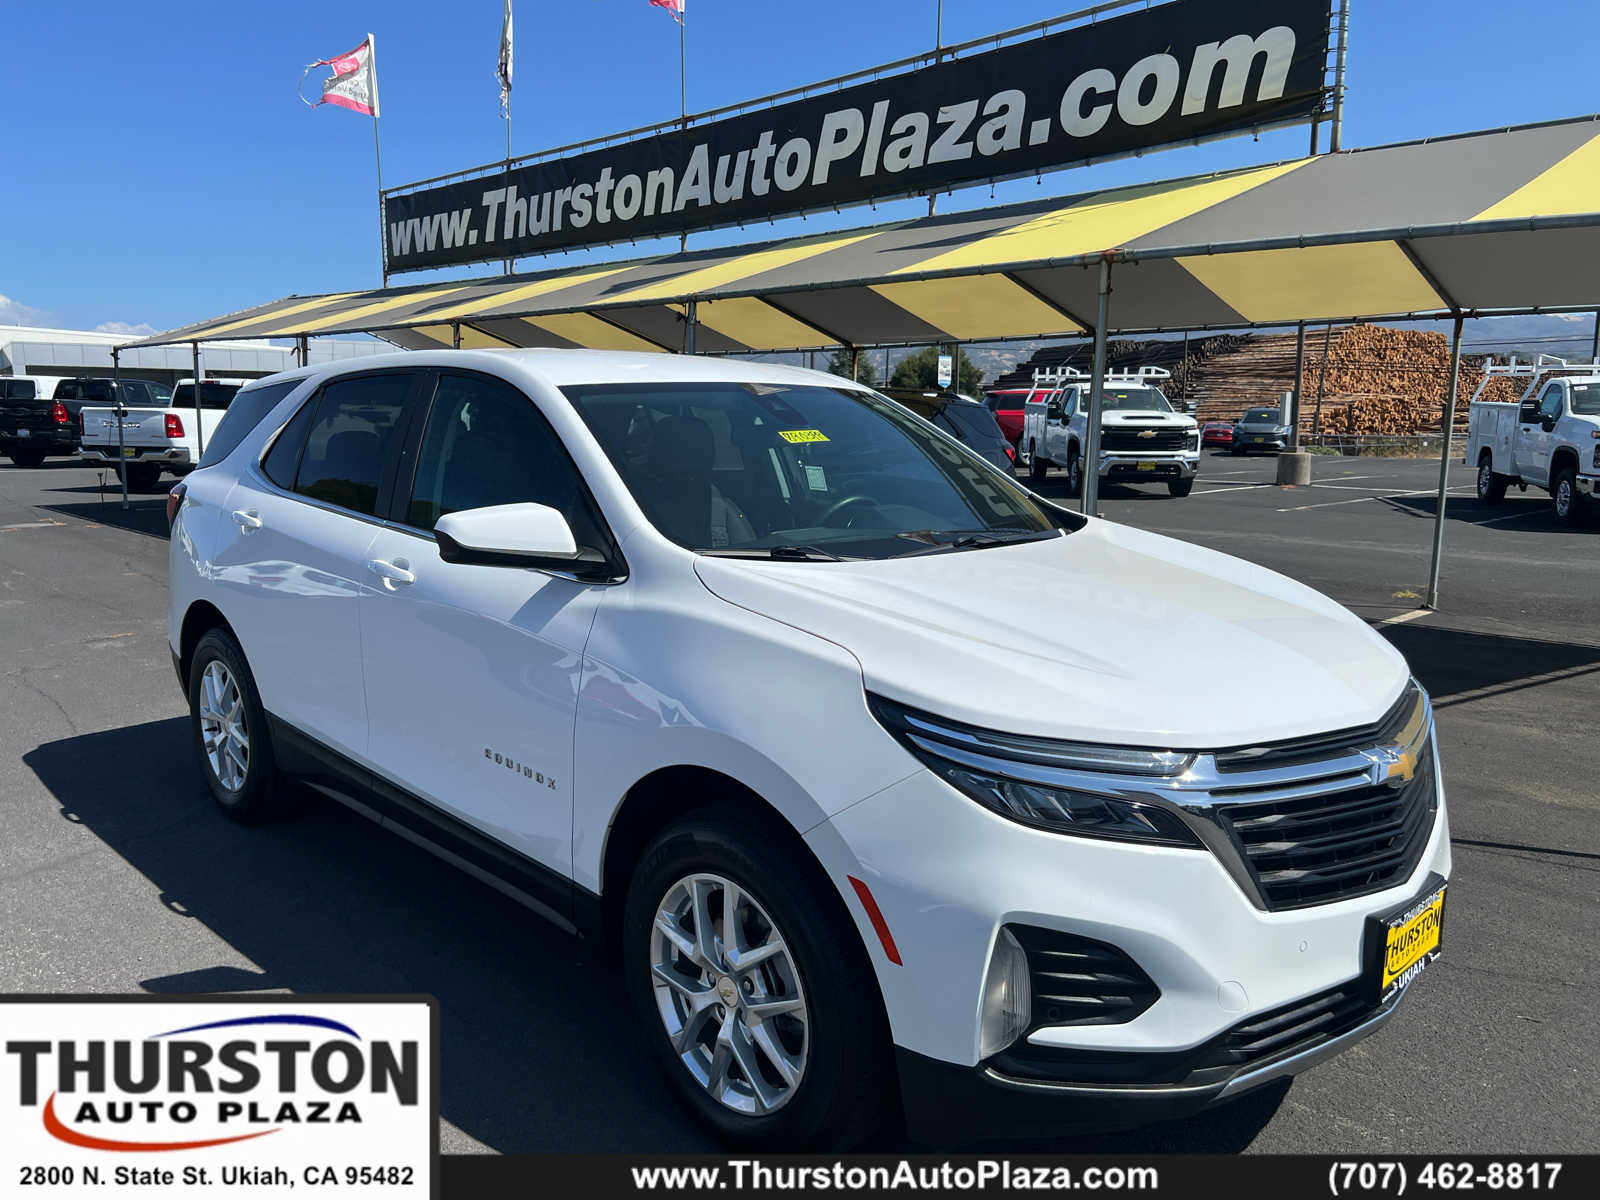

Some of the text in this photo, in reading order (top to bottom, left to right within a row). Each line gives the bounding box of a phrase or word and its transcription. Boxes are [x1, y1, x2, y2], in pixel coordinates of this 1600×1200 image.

[390, 25, 1296, 257] www.ThurstonAutoPlaza.com
[484, 747, 556, 790] EQUINOX
[1385, 906, 1441, 968] THURSTON
[1398, 957, 1425, 989] UKIAH
